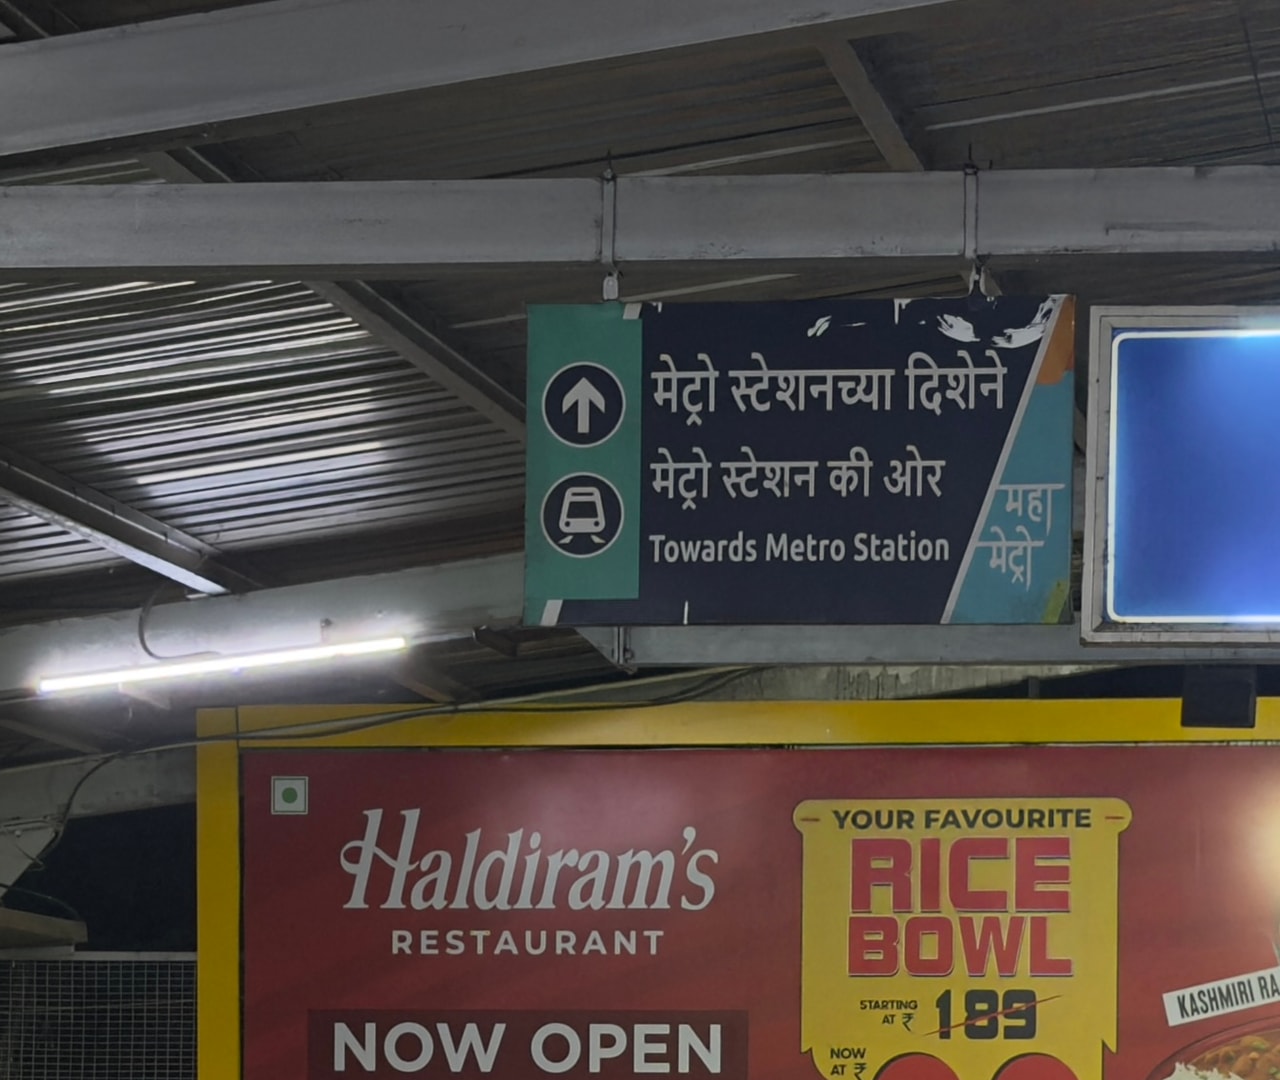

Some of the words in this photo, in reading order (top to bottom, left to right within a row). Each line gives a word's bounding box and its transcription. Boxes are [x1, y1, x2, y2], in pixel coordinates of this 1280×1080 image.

[651, 353, 719, 426] मेट्रो
[728, 351, 895, 414] स्टेशनच्या
[903, 349, 1008, 416] दिशेने
[650, 447, 712, 511] मेट्रो
[721, 446, 819, 499] स्टेशन
[827, 446, 873, 498] की
[883, 445, 947, 498] ओर
[997, 482, 1066, 536] महा
[649, 533, 757, 563] Towards
[765, 532, 846, 562] Metro
[854, 531, 950, 562] Station
[978, 525, 1045, 592] मेट्रो
[832, 809, 915, 831] YOUR
[924, 808, 1092, 830] FAVOURITE
[339, 806, 719, 911] Haldiram's
[850, 836, 1072, 914] RICE
[392, 929, 665, 956] RESTAURANT
[847, 915, 1074, 977] BOWL
[860, 999, 918, 1011] STARTING
[882, 1012, 896, 1025] AT
[935, 988, 1038, 1040] 189
[1176, 975, 1256, 1020] KASHMIRI
[332, 1021, 506, 1073] NOW
[530, 1022, 722, 1074] OPEN
[829, 1047, 866, 1061] NOW
[829, 1063, 847, 1076] AT
